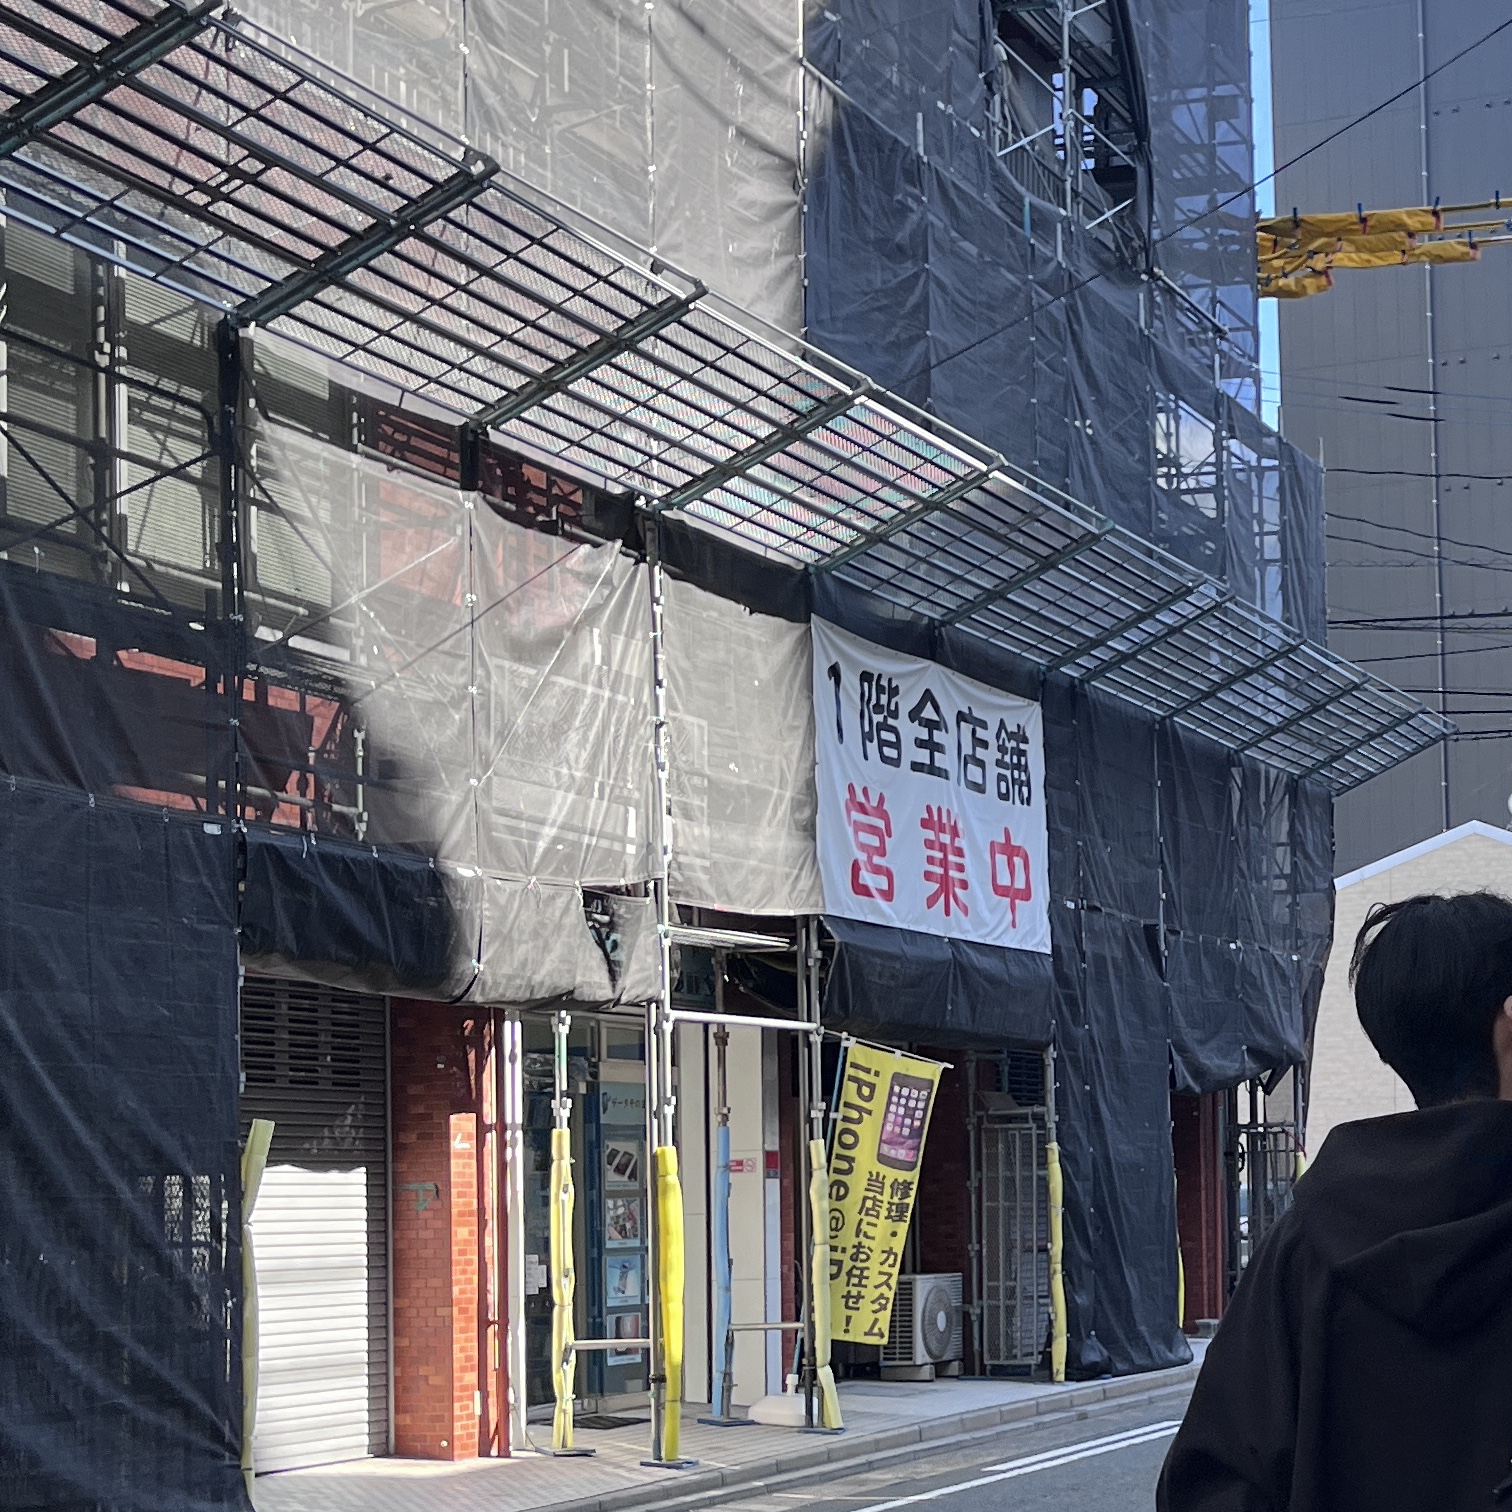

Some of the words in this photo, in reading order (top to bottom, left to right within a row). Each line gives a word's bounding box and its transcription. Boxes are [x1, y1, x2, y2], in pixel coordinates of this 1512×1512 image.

[828, 661, 1032, 806] 1階全店舗
[845, 782, 1032, 929] 営業中
[864, 1178, 914, 1340] 修理・カスタム
